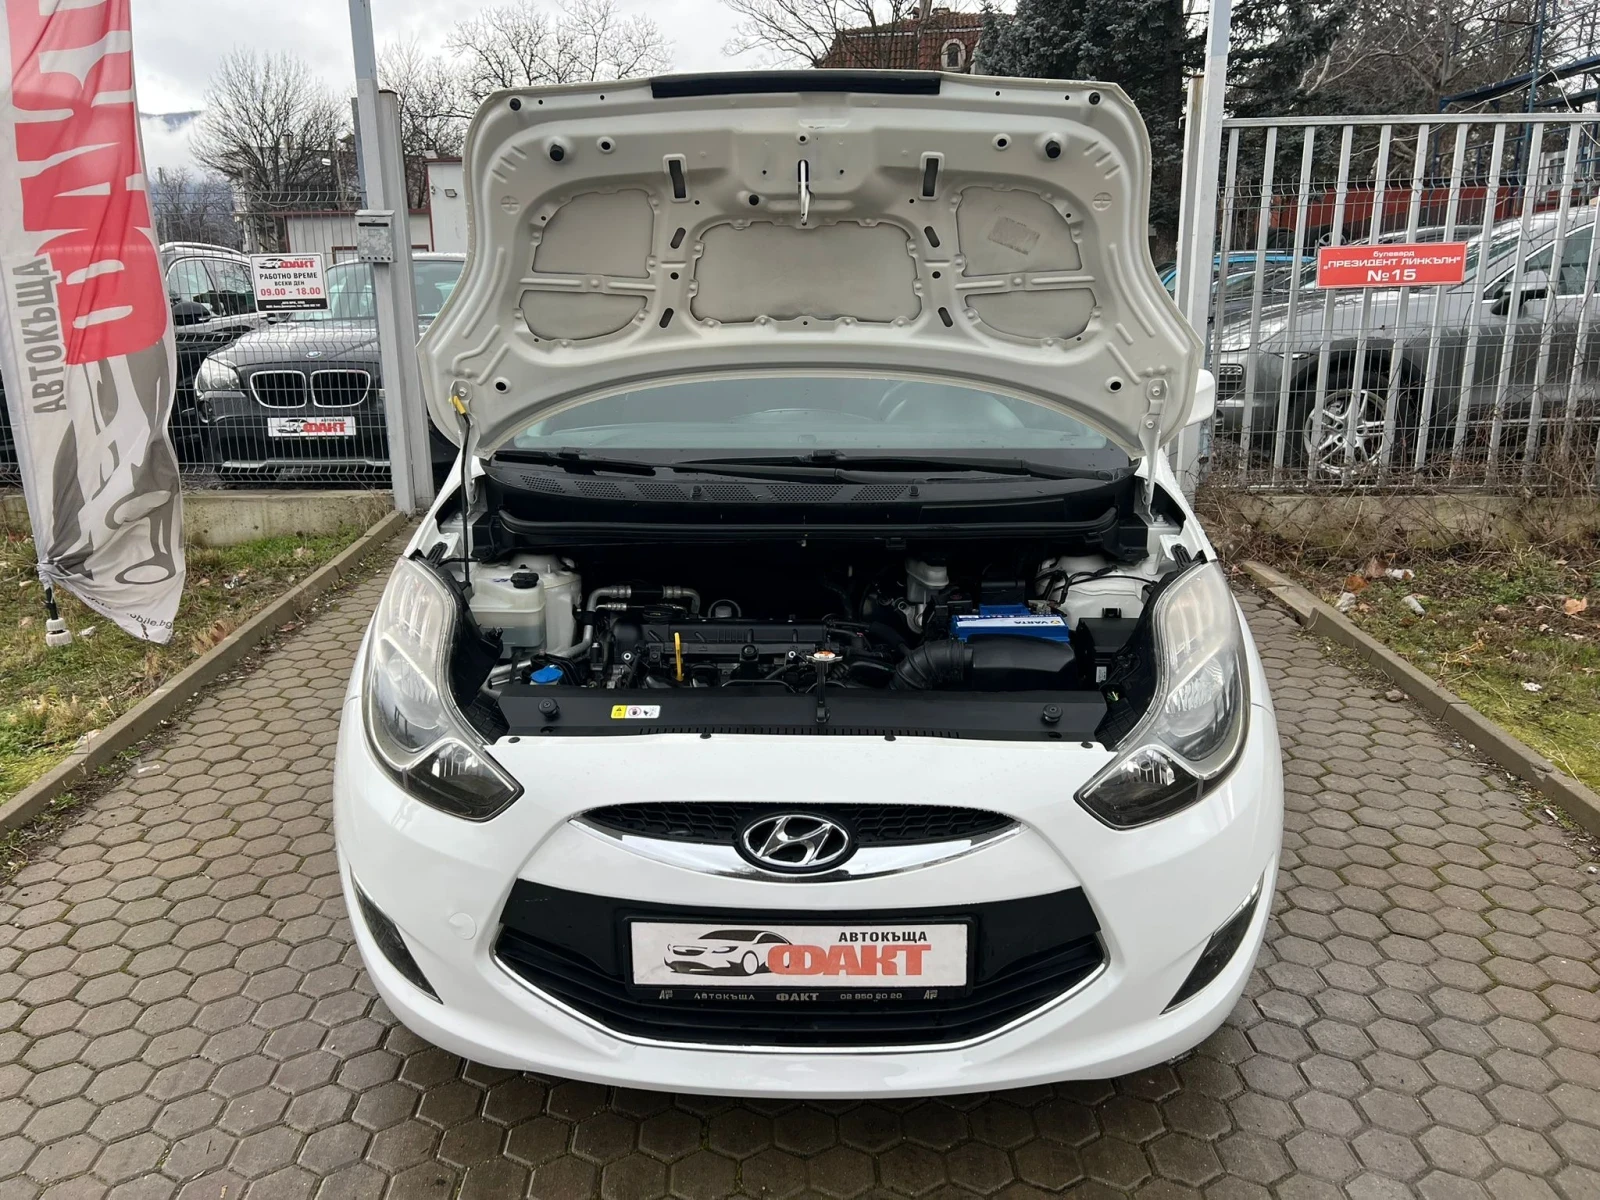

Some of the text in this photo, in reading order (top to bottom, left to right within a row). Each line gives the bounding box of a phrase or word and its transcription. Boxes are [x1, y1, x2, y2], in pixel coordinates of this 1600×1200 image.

[1373, 250, 1415, 258] булевард
[280, 260, 315, 268] ФАКТ
[260, 288, 286, 296] 09.00
[295, 287, 321, 295] 18.00
[12, 257, 67, 413] АВТОКЪЩА
[303, 422, 346, 433] ФАКТ
[838, 931, 928, 943] АВТОКЪЩА
[767, 944, 932, 976] ФАКТ
[775, 992, 820, 1002] ФАКТ
